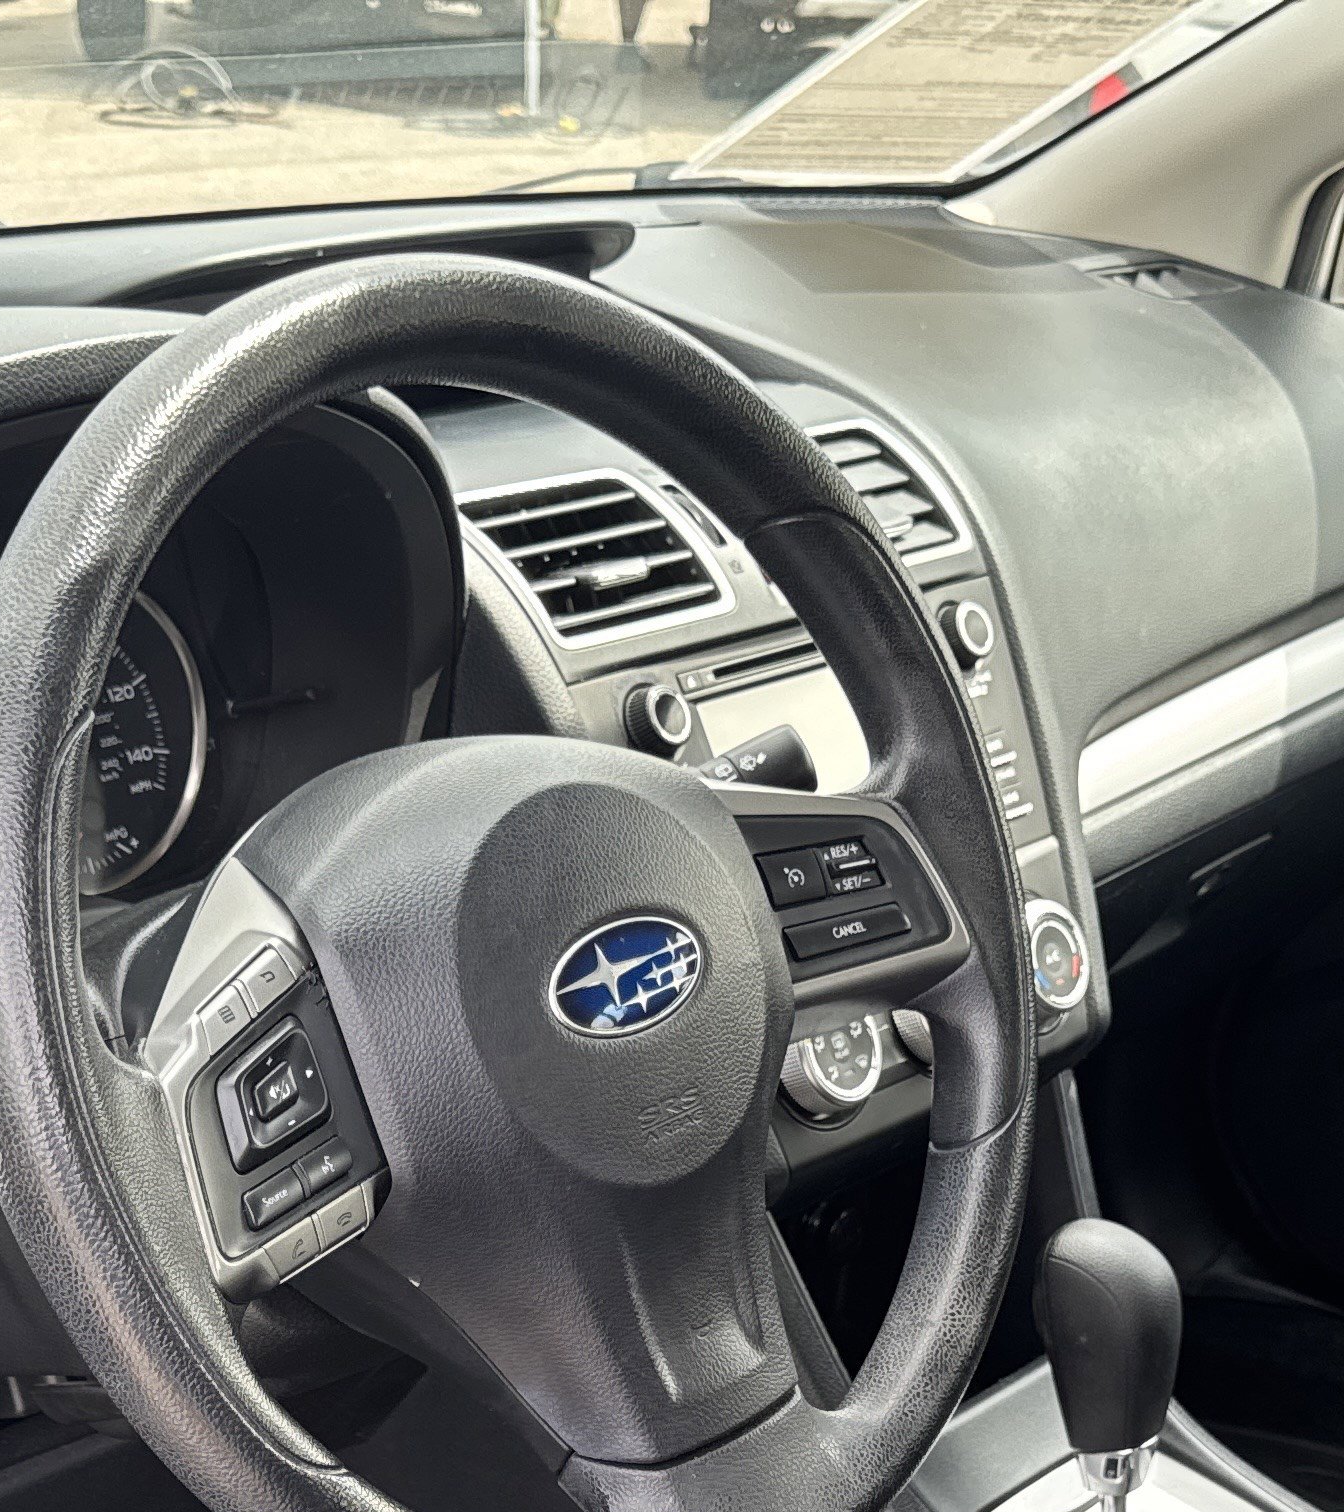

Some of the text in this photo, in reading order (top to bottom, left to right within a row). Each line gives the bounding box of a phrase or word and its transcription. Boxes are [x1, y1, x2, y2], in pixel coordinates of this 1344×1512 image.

[106, 684, 136, 703] 120
[125, 745, 154, 765] 140
[832, 922, 867, 939] CANCEL
[261, 1189, 289, 1208] Source
